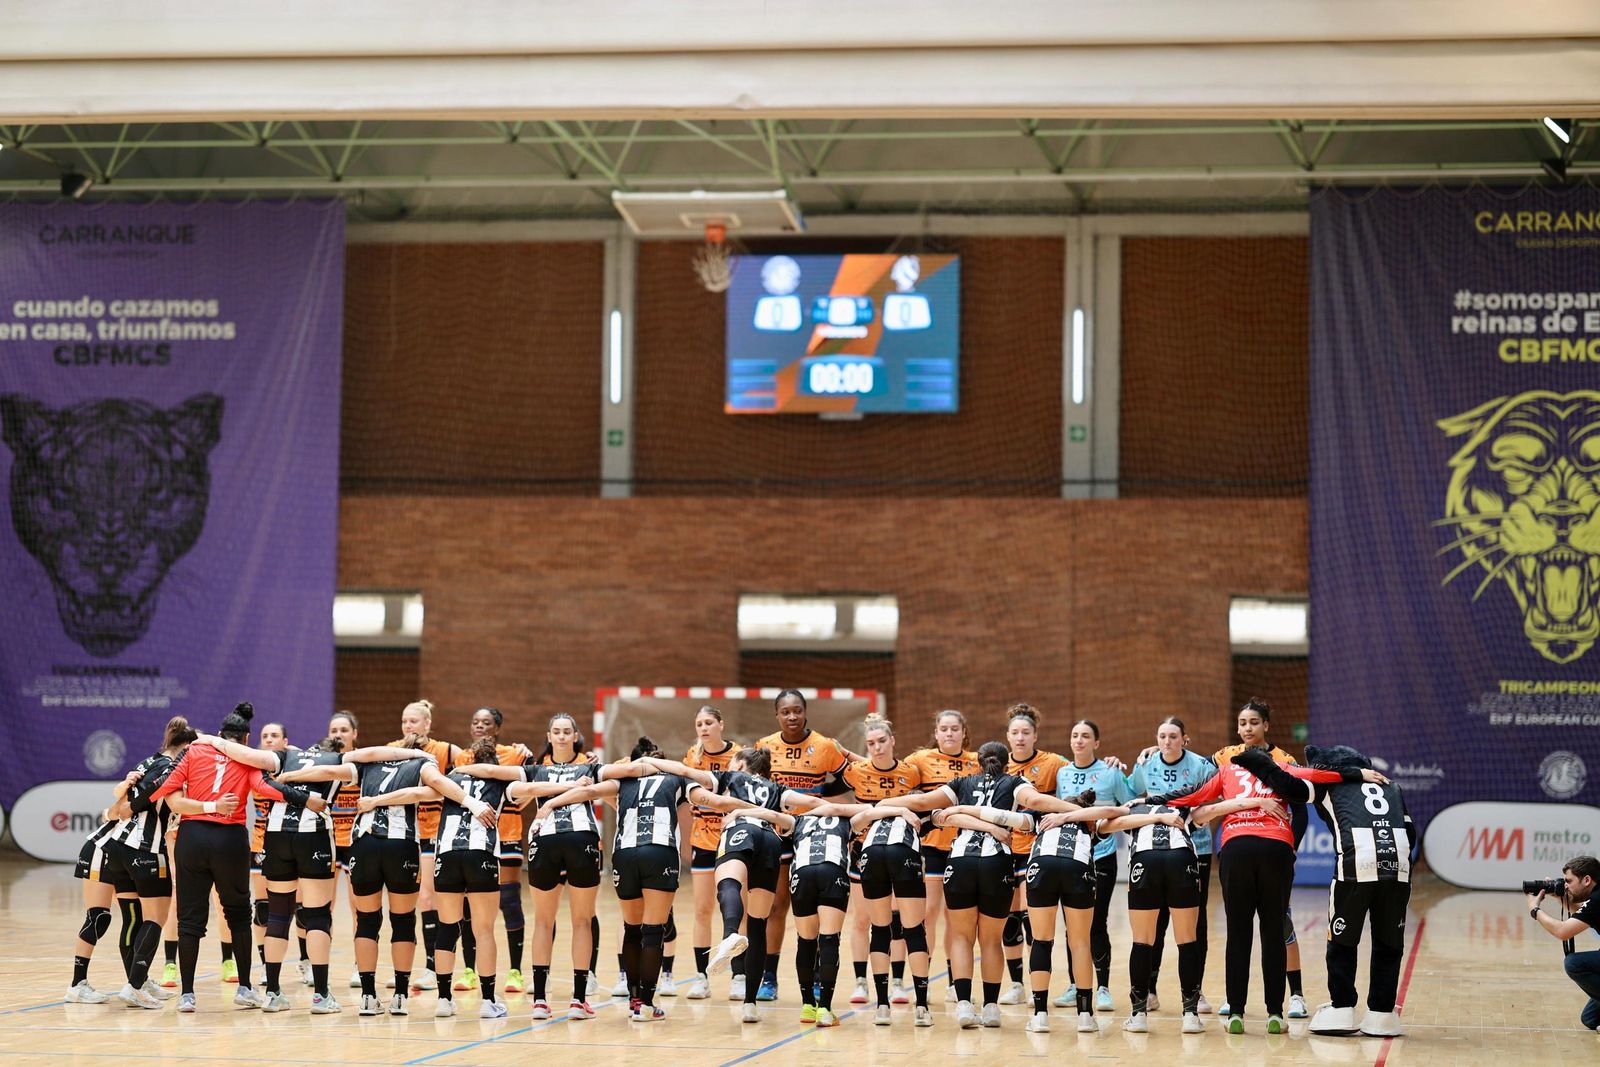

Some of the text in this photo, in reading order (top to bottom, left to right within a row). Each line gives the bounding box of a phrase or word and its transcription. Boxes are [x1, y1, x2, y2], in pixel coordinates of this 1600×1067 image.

[1475, 211, 1600, 233] CARRAN
[39, 223, 197, 246] CARRANQUE
[13, 296, 219, 318] cuando cazamos
[0, 318, 236, 342] en casa, triunfamos
[1452, 310, 1537, 333] reinas
[1542, 311, 1577, 333] de
[53, 345, 172, 367] CBFMCS
[1498, 338, 1600, 363] CBFMC
[810, 362, 874, 394] 00:00
[1490, 713, 1512, 725] EHF
[1515, 713, 1580, 725] EUROPEAN
[786, 748, 801, 759] 20
[949, 760, 963, 771] 28
[1163, 770, 1177, 782] 55
[212, 763, 227, 793] 1
[379, 766, 399, 793] 7
[638, 776, 665, 801] 17
[788, 776, 815, 784] super
[880, 777, 895, 789] 25
[1072, 773, 1086, 785] 33
[338, 796, 359, 805] supe
[744, 781, 770, 808] 19
[1361, 782, 1390, 815] 8
[1373, 819, 1391, 827] raíz
[1533, 830, 1592, 844] metro
